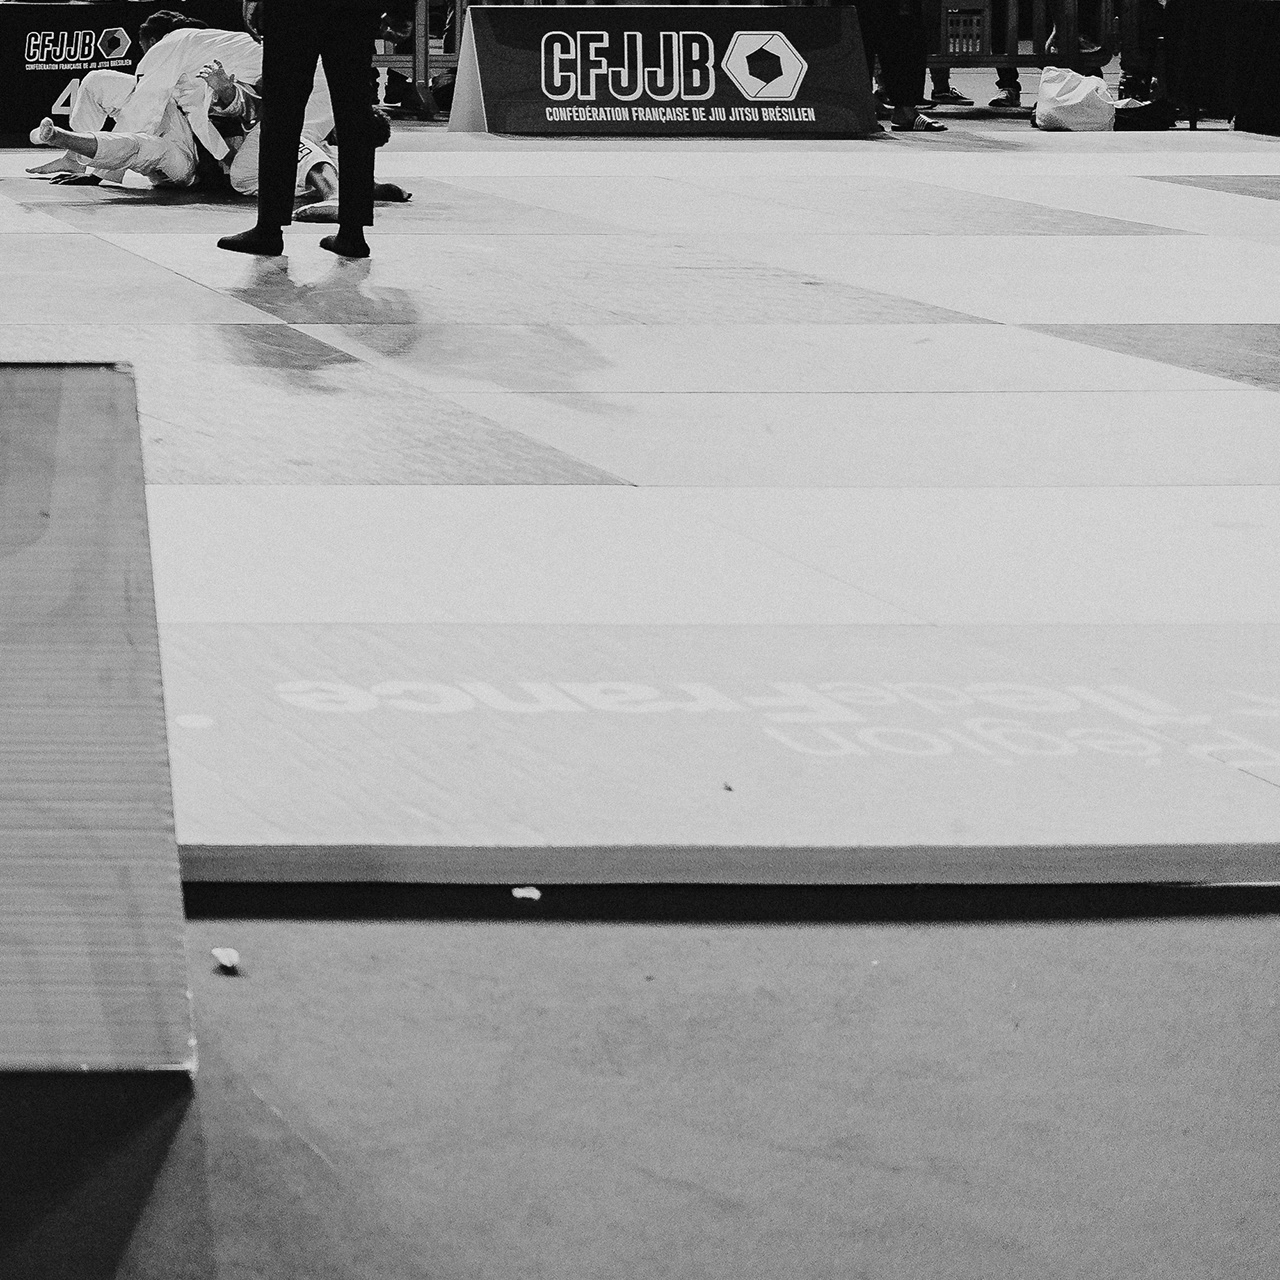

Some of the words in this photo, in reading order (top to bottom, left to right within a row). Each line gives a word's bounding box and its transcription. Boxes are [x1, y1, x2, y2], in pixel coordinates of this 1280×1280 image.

[24, 30, 96, 62] CFJJB
[541, 30, 716, 101] CFJJB
[51, 78, 80, 115] 4
[545, 105, 629, 122] CONFÉDÉRATION
[631, 107, 690, 124] FRANÇAISE
[692, 107, 707, 121] DE
[709, 107, 726, 122] JIU
[729, 107, 760, 122] JITSU
[761, 105, 816, 122] BRÉSILIEN
